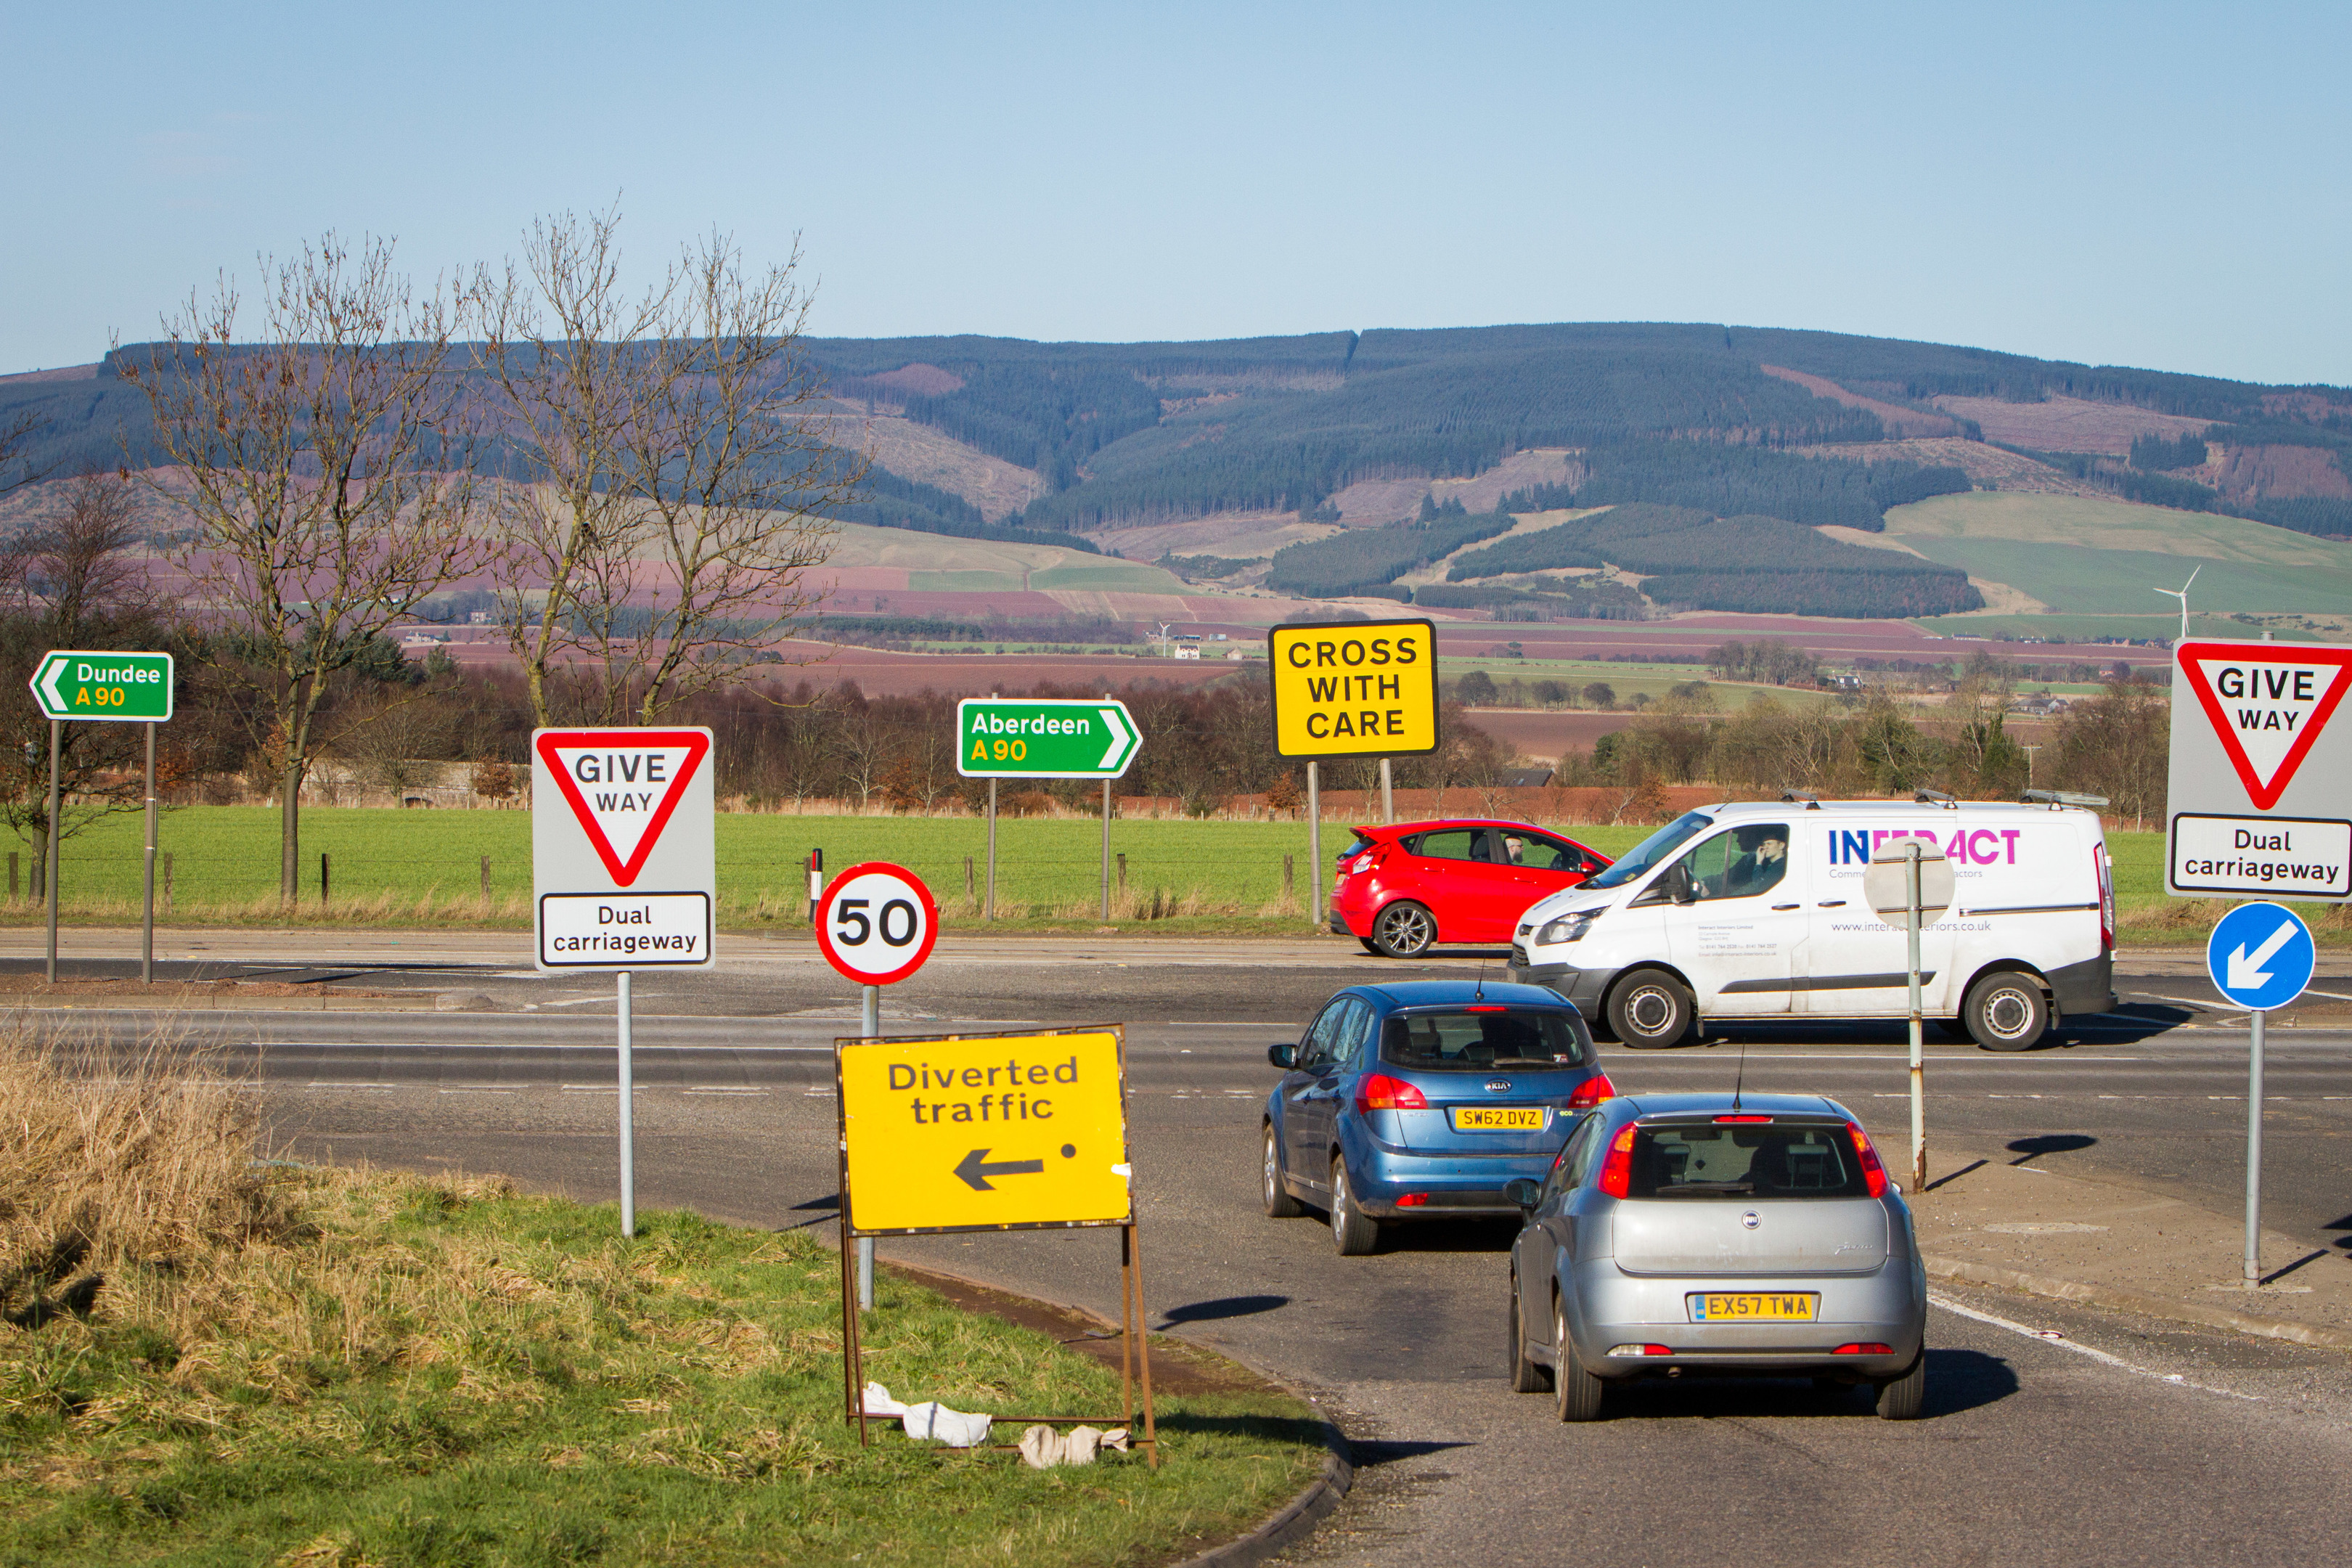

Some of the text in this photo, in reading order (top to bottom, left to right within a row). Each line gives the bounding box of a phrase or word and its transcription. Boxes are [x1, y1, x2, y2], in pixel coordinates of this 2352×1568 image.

[1289, 637, 1416, 668] CROSS
[78, 663, 160, 683] Dundee
[2217, 667, 2314, 701] GIVE
[1307, 674, 1400, 702] WITH
[971, 714, 1090, 735] Aberdeen
[1307, 709, 1405, 738] CARE
[2238, 709, 2299, 731] WAY
[576, 754, 666, 783] GIVE
[595, 793, 653, 812] WAY
[2234, 829, 2291, 852] Dual
[2185, 857, 2339, 884] carriageway
[599, 905, 652, 925] Dual
[836, 898, 918, 947] 50
[554, 931, 697, 954] carriageway
[889, 1056, 1078, 1090] Diverted
[911, 1093, 1053, 1124] traffic
[1464, 1111, 1536, 1124] SW62 DVZ
[1710, 1297, 1808, 1315] EX57 TWA
